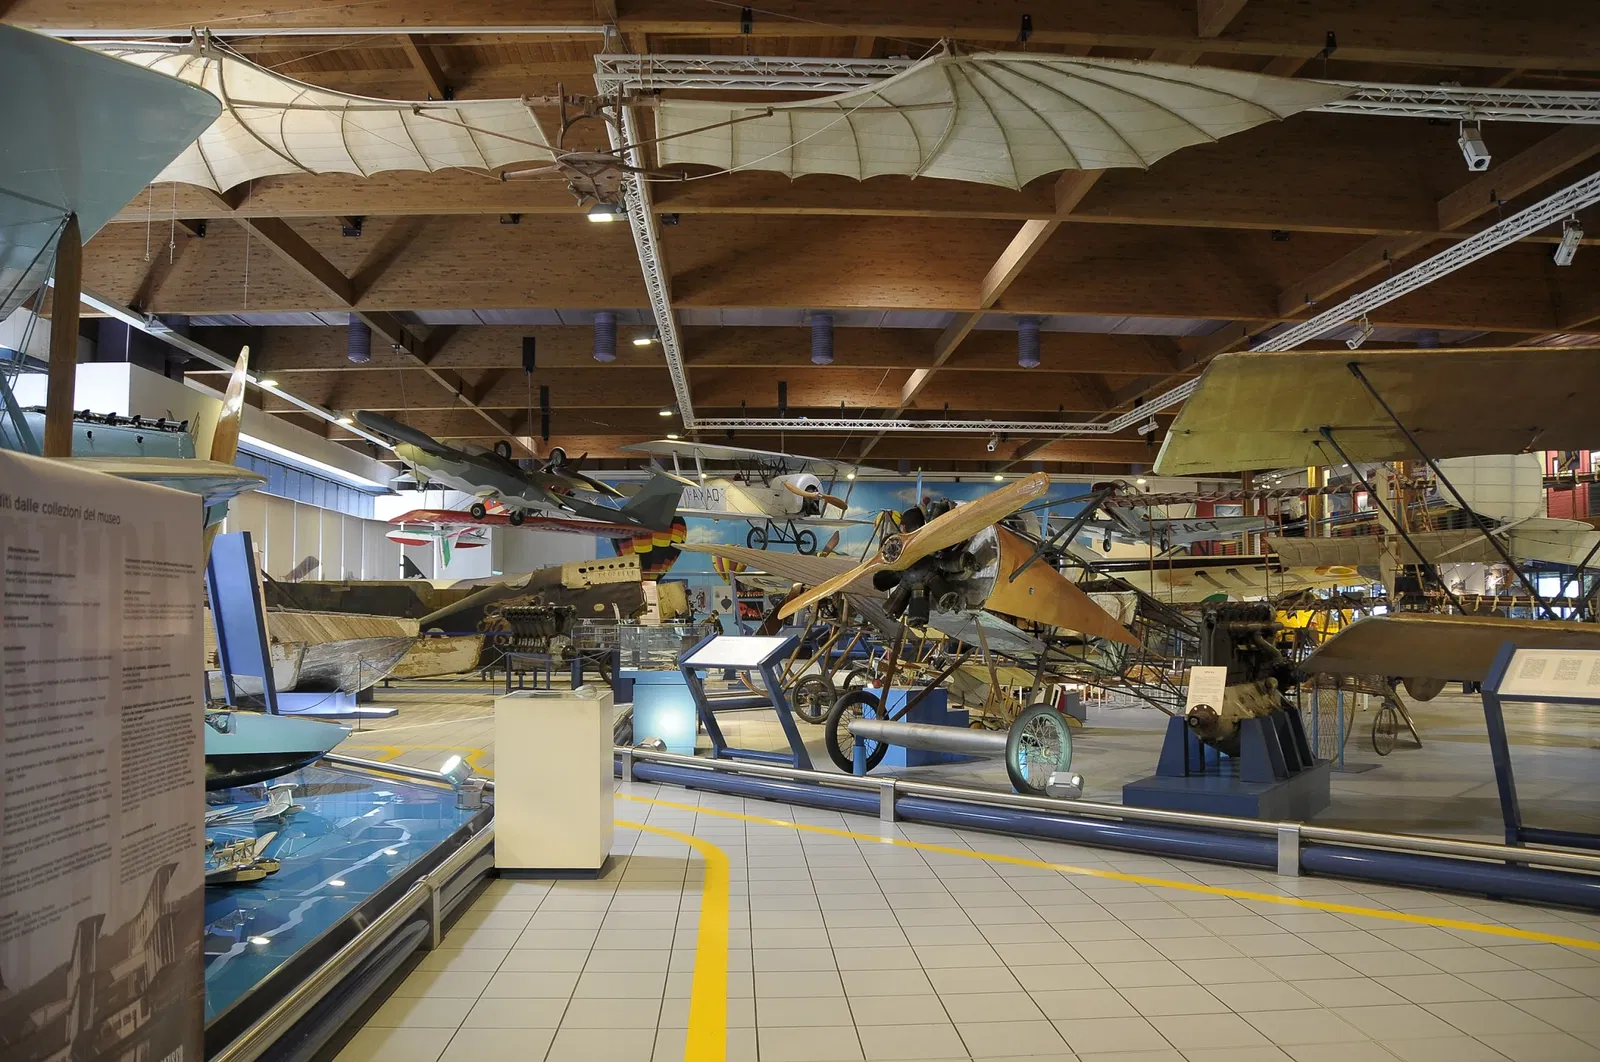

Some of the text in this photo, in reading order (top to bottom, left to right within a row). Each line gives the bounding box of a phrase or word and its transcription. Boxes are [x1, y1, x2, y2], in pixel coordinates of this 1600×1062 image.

[14, 495, 39, 513] dalle
[42, 502, 82, 520] collezioni
[83, 508, 96, 521] del
[97, 512, 121, 525] museo
